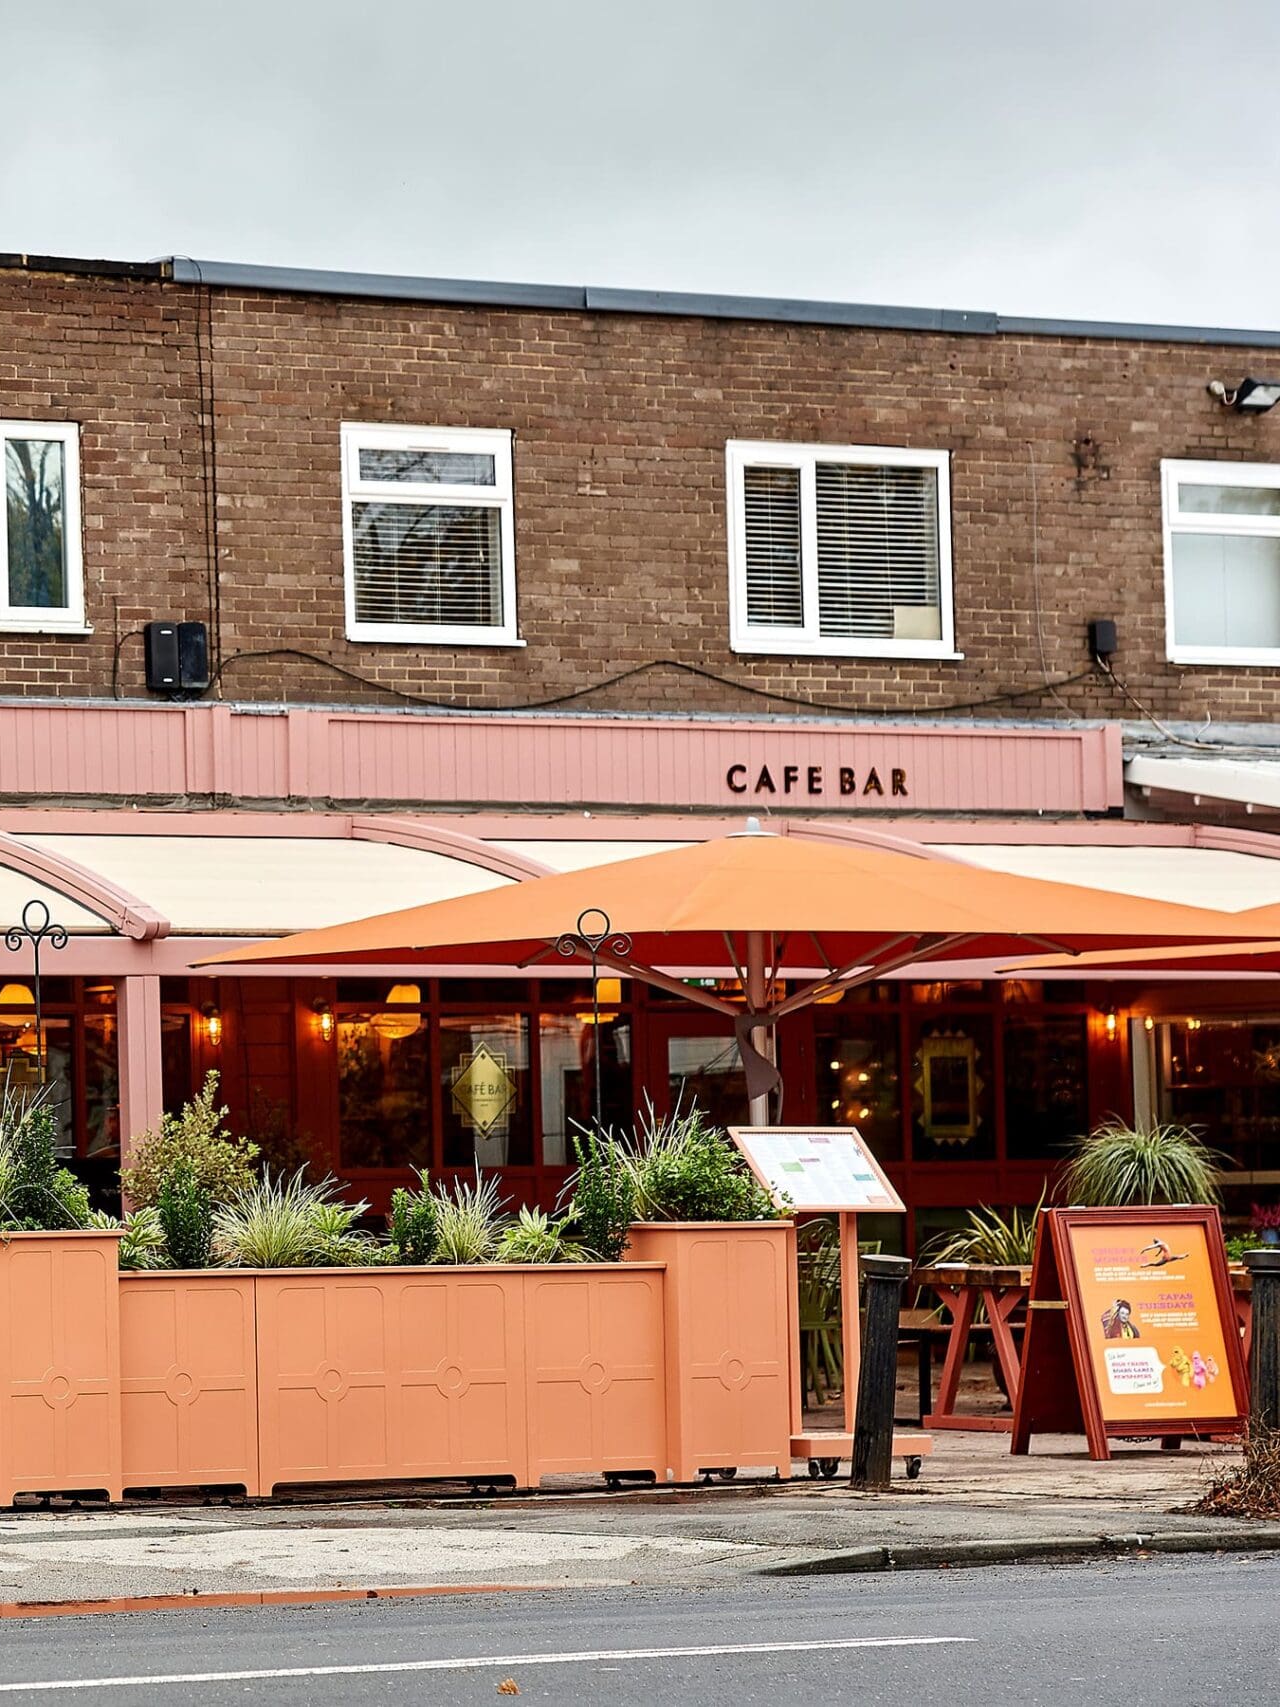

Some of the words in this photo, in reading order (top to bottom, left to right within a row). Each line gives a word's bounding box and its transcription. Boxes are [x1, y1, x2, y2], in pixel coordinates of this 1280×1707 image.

[726, 764, 822, 794] CAFE
[839, 766, 908, 796] BAR
[1158, 1292, 1193, 1300] TAPAS
[1137, 1301, 1195, 1310] TUESDAYS
